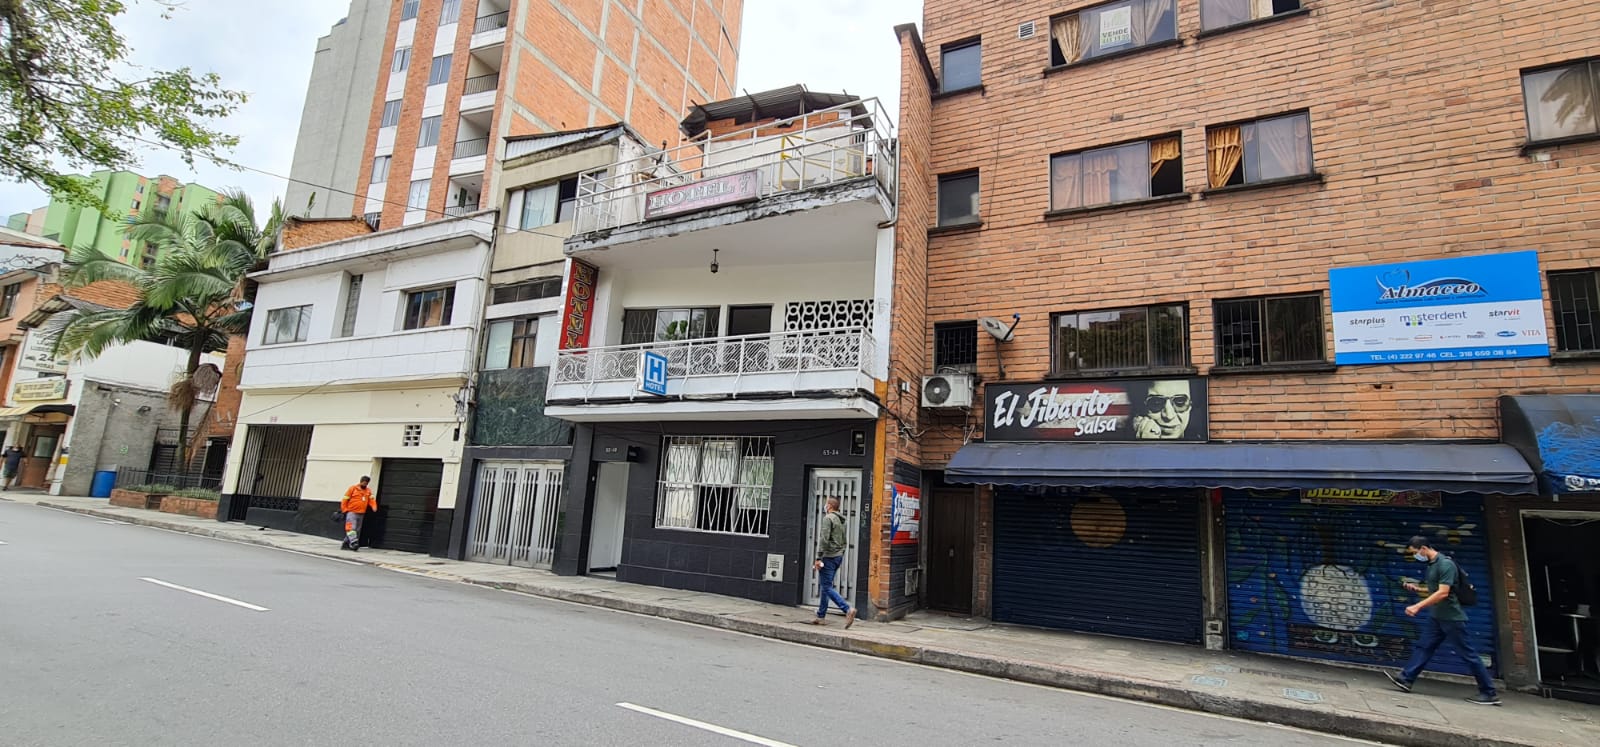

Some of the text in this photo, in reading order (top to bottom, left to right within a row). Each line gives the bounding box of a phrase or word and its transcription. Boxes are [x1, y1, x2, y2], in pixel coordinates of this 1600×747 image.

[649, 180, 734, 210] HOTEL
[1379, 283, 1480, 300] Almaceo
[565, 262, 593, 349] HOTEL
[1489, 309, 1520, 317] starvit
[1350, 317, 1385, 326] starplus
[1400, 310, 1467, 322] masterdent
[645, 381, 664, 393] HOTEL
[993, 386, 1116, 429] El Jibarito
[1074, 418, 1116, 437] Salsa
